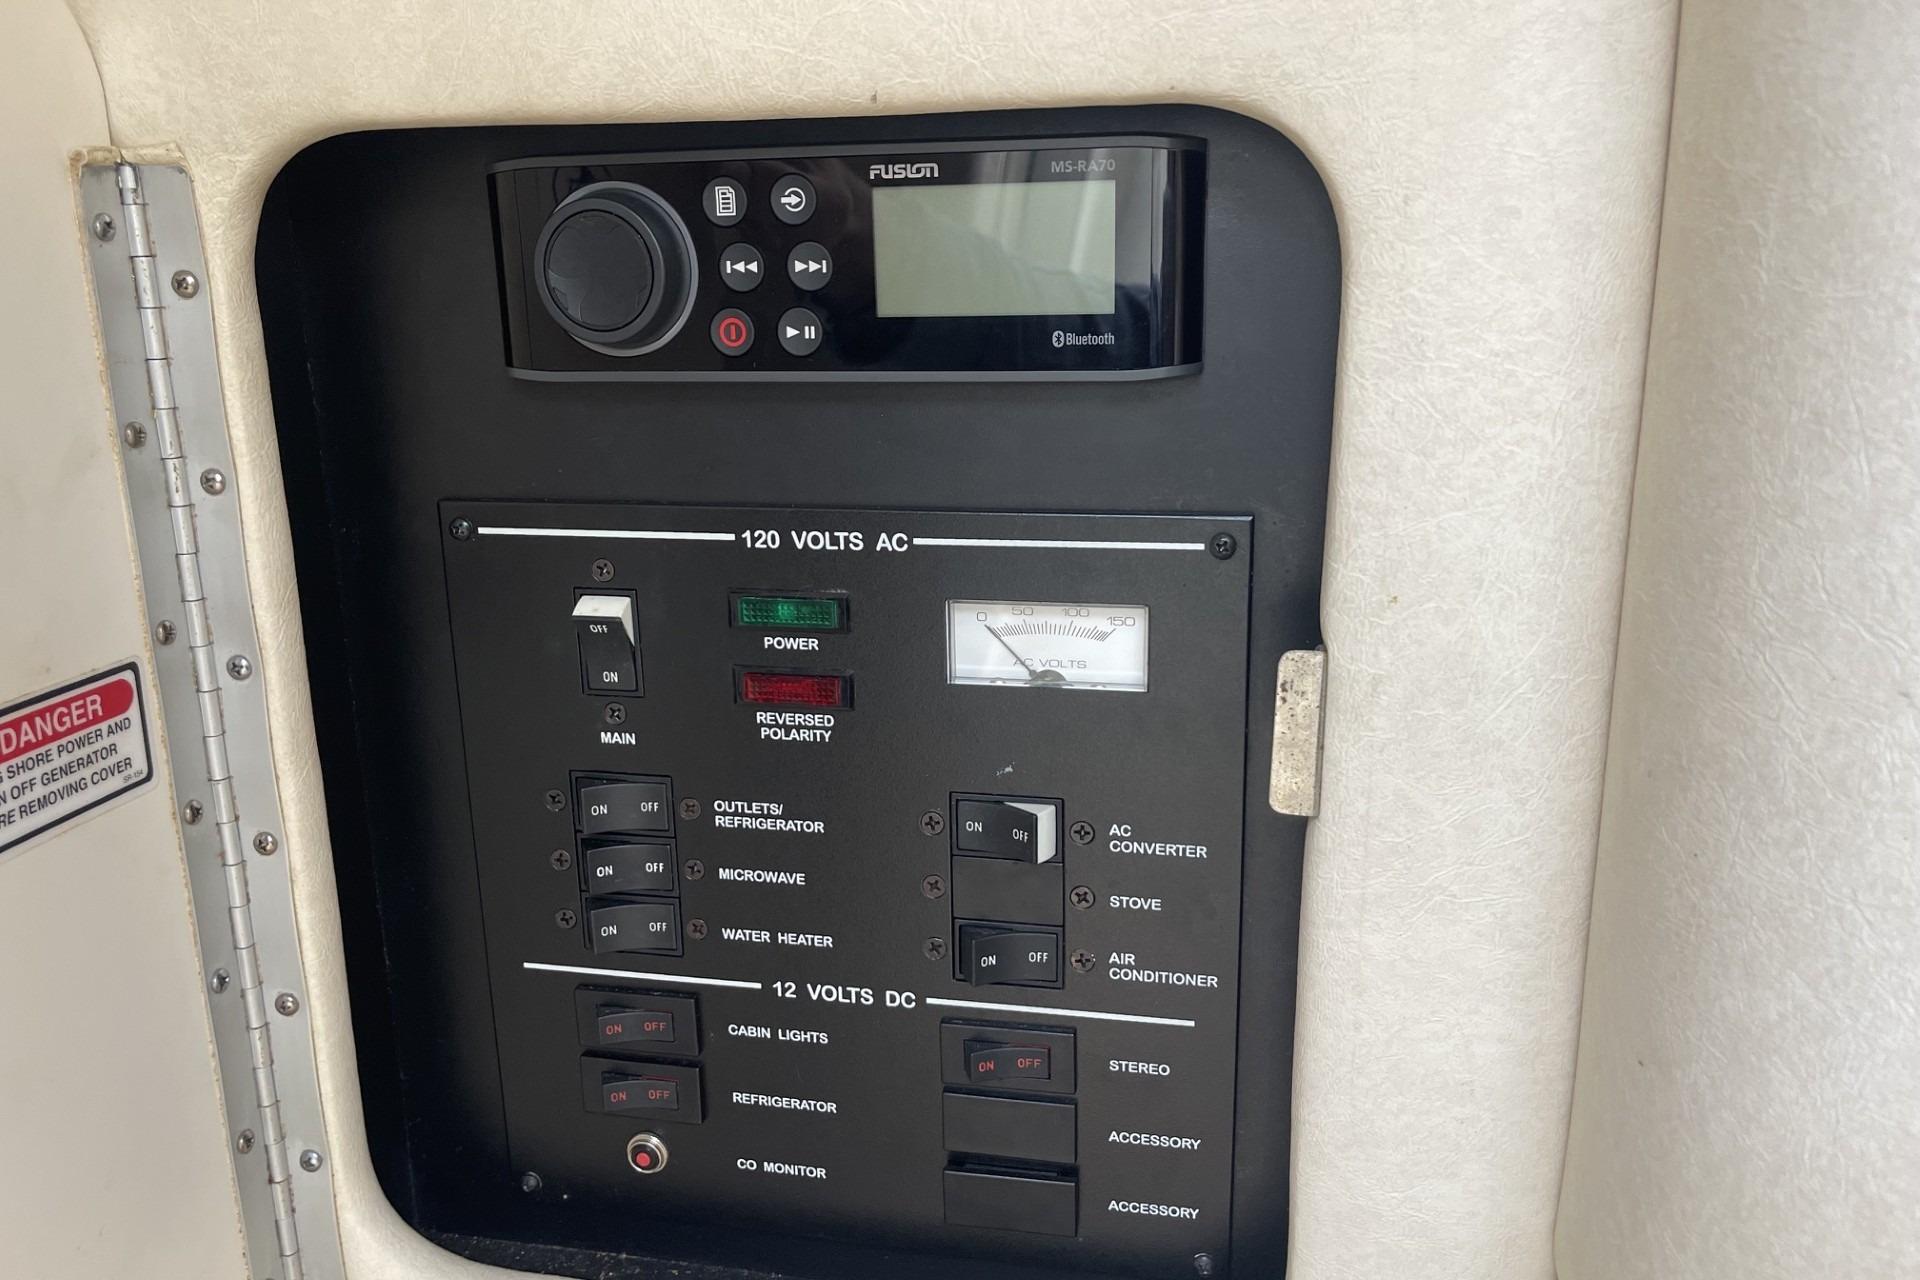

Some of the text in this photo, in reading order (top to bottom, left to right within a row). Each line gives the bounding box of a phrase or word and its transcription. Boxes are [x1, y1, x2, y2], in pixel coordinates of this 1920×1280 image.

[869, 162, 939, 180] FUSION
[1051, 158, 1116, 174] MS-RA70
[1066, 332, 1115, 347] Bluetooth
[741, 529, 909, 552] 120 VOLTS AC
[976, 606, 1136, 627] 0 50 100 150
[589, 624, 608, 633] OFF
[763, 636, 819, 651] POWER
[1039, 658, 1088, 669] VOLTS
[602, 671, 619, 683] ON
[0, 694, 103, 754] DANGER
[757, 711, 834, 727] REVERSED
[600, 731, 636, 745] MAIN
[761, 727, 832, 742] POLARITY
[7, 749, 54, 780] SHORE
[57, 729, 104, 758] POWER
[106, 716, 132, 738] AND
[11, 777, 37, 800] OFF
[41, 743, 118, 786] GENERATOR
[19, 778, 89, 819] REMOVING
[91, 757, 133, 785] COVER
[591, 801, 659, 816] ON OFF
[714, 800, 783, 815] OUTLETS/
[714, 815, 825, 833] REFRIGERATOR
[965, 820, 1029, 843] ON OFF
[1109, 823, 1132, 837] AC
[1109, 840, 1207, 859] CONVERTER
[596, 862, 664, 878] ON OFF
[718, 867, 806, 886] MICROWAVE
[1109, 895, 1162, 911] STOVE
[600, 922, 667, 937] ON OFF
[721, 927, 833, 948] WATER HEATER
[980, 951, 1049, 968] ON OFF
[1109, 952, 1136, 965] AIR
[1109, 968, 1218, 988] CONDITIONER
[772, 981, 916, 1009] 12 VOLTS DC
[604, 1019, 666, 1036] ON OFF
[727, 1024, 829, 1044] CABIN LIGHTS
[977, 1056, 1041, 1073] ON OFF
[1109, 1059, 1171, 1076] STEREO
[610, 1088, 670, 1104] ON OFF
[732, 1091, 837, 1114] REFRIGERATOR
[1108, 1130, 1202, 1150] ACCESSORY
[736, 1158, 827, 1179] CO MONITOR
[1107, 1200, 1200, 1220] ACCESSORY
